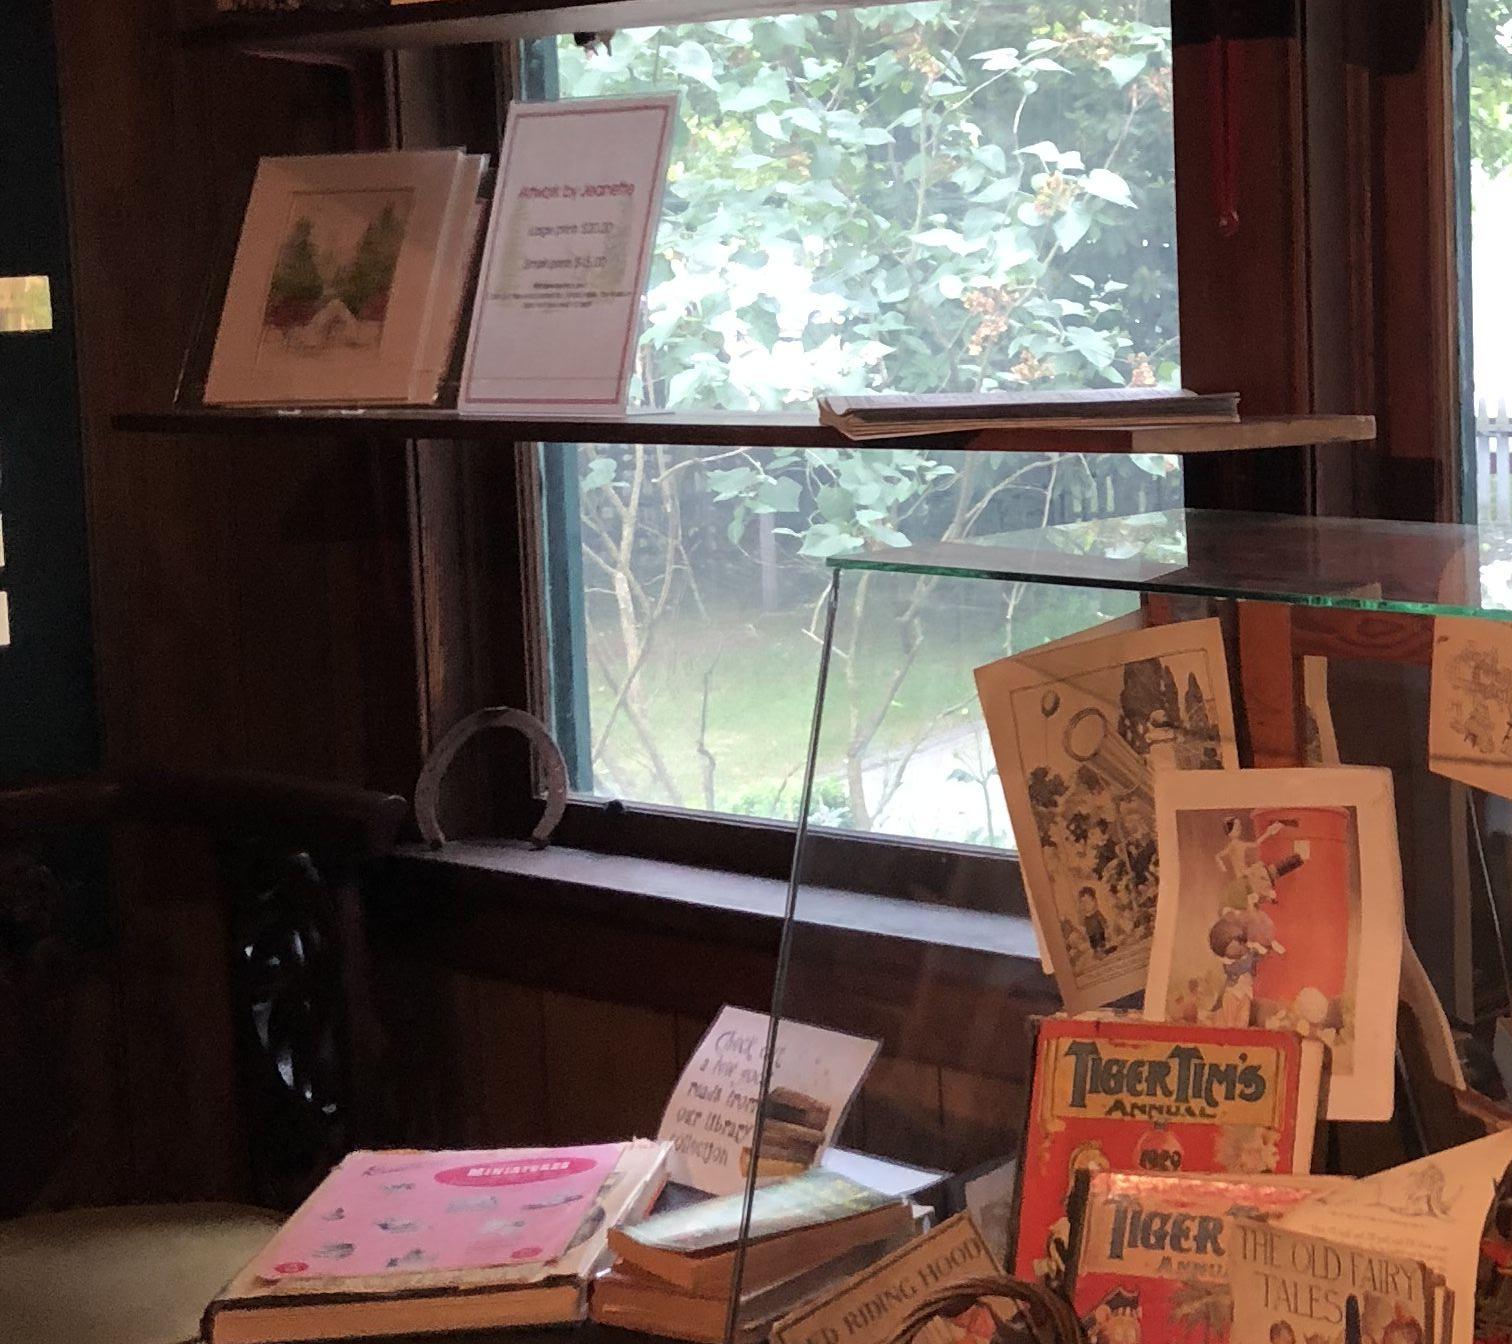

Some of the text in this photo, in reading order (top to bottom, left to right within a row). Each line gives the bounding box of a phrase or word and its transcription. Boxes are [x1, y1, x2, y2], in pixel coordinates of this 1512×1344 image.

[1065, 1039, 1175, 1108] TIGER
[1104, 1098, 1217, 1119] ANNUAL
[466, 1160, 571, 1178] MINIATURES
[1104, 1193, 1227, 1260] TIGER
[841, 1283, 918, 1335] RIDING
[917, 1235, 985, 1287] HOOD
[1236, 1224, 1286, 1268] THE
[1291, 1242, 1343, 1282] OLD
[1349, 1250, 1414, 1302] FAIRY
[1254, 1269, 1345, 1325] TALES
